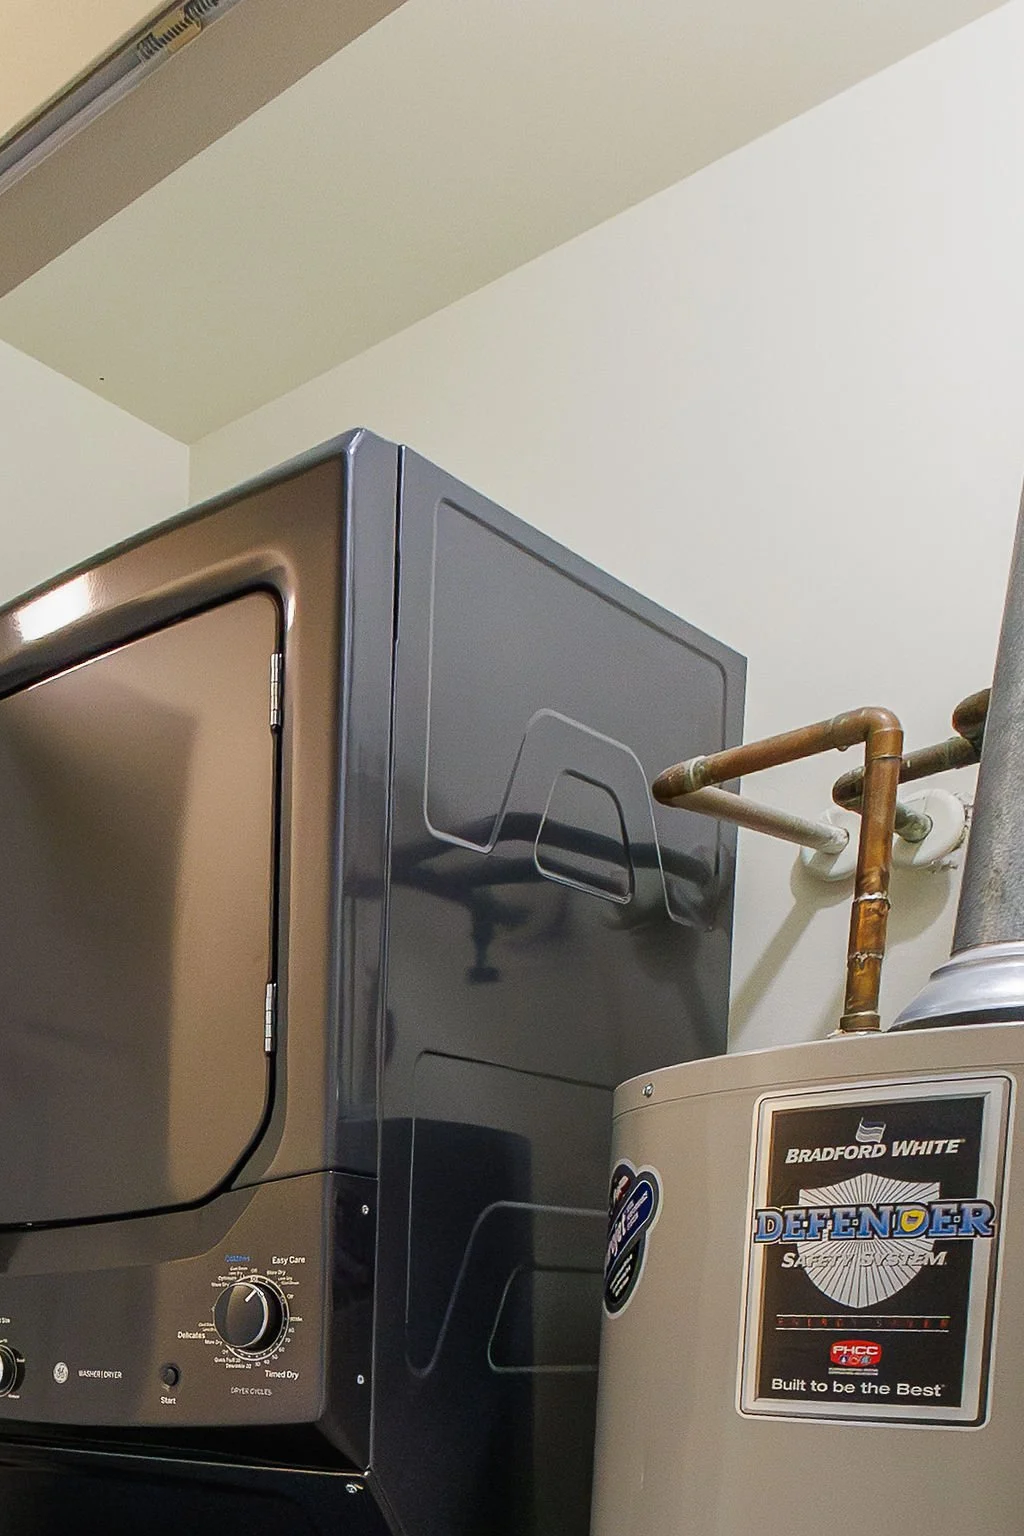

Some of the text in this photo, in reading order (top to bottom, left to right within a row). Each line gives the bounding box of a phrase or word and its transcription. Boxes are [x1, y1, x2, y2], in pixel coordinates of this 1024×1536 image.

[785, 1139, 960, 1163] BRADFORD WHITE
[754, 1200, 996, 1242] DEFENDER
[271, 1255, 306, 1265] Easy Care
[780, 1251, 854, 1269] SAFETY
[177, 1331, 206, 1339] Delicates
[832, 1345, 879, 1355] PHCC
[264, 1369, 300, 1380] Timed Dry
[771, 1378, 942, 1397] Built to be the Best
[160, 1396, 176, 1405] Start
